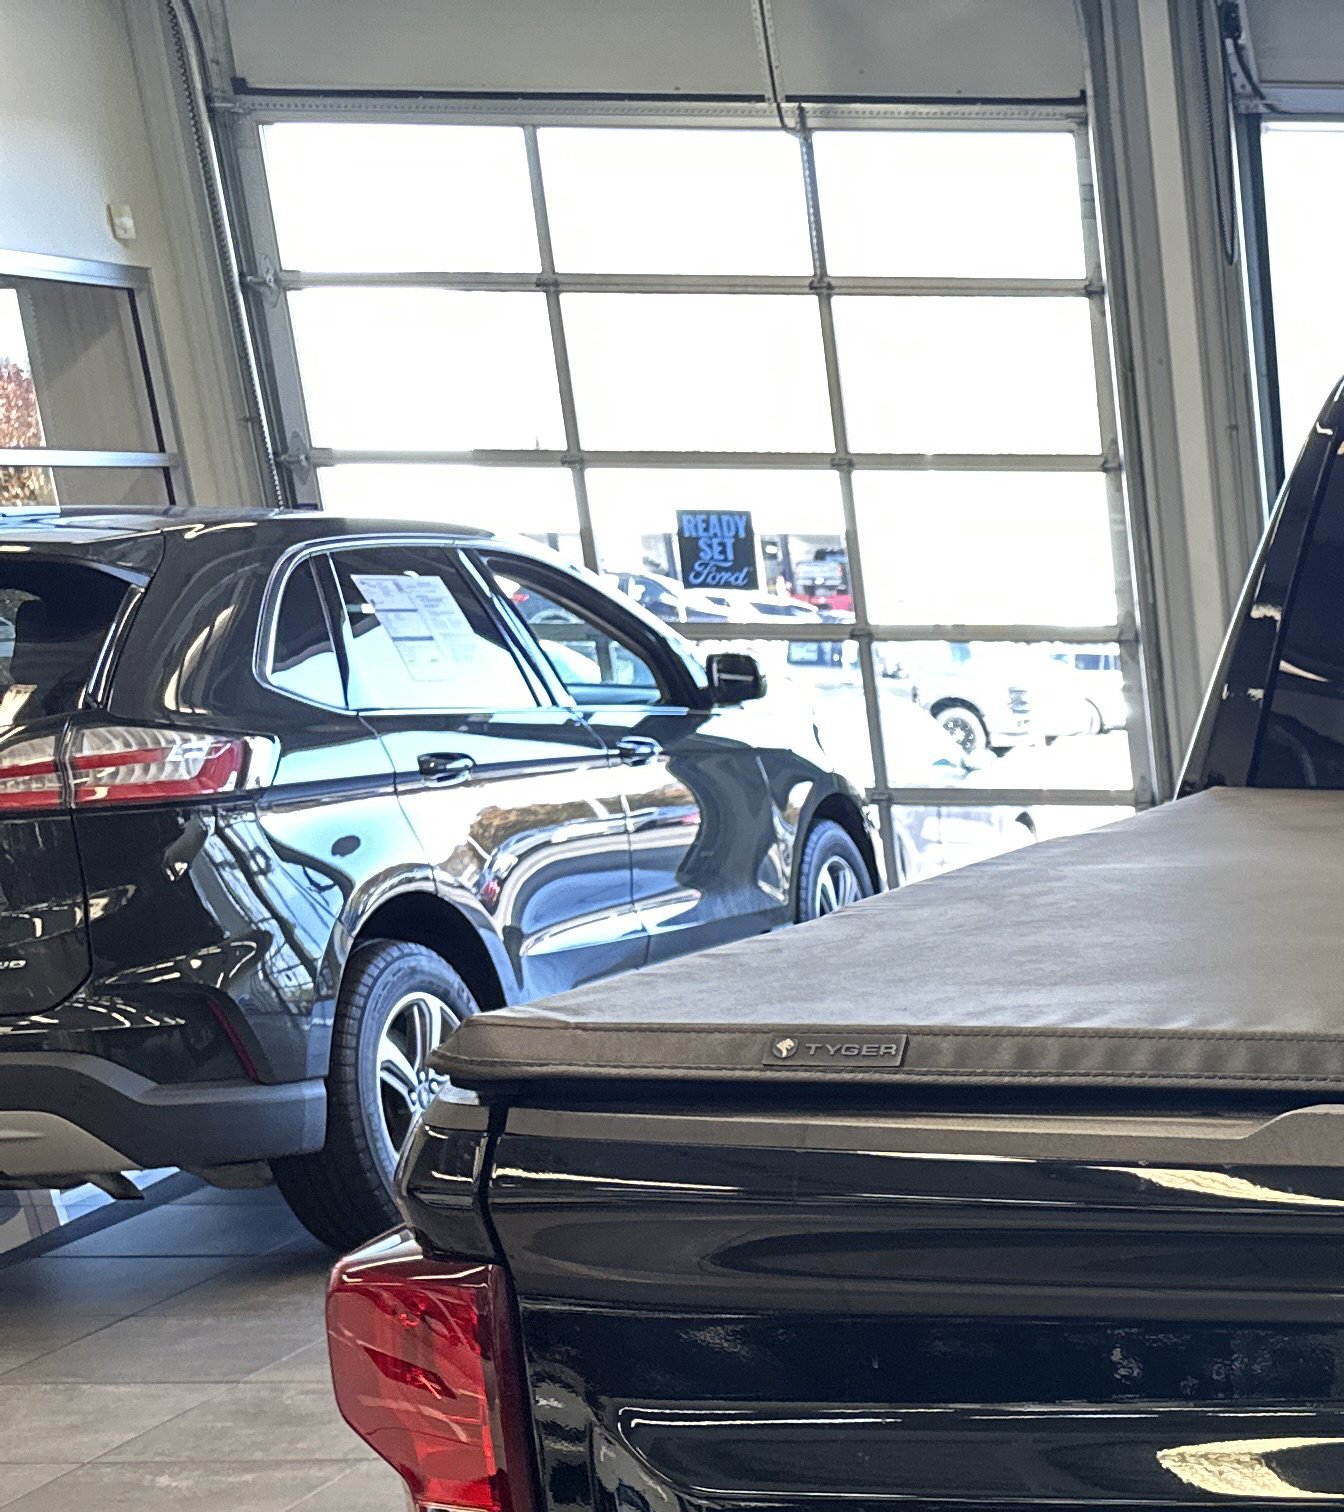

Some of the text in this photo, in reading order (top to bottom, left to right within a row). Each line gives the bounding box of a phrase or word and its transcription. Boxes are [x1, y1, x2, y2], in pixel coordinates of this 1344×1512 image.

[682, 514, 747, 538] READY
[698, 537, 736, 560] SET
[688, 560, 749, 586] Ford
[805, 1043, 898, 1057] TYGER
